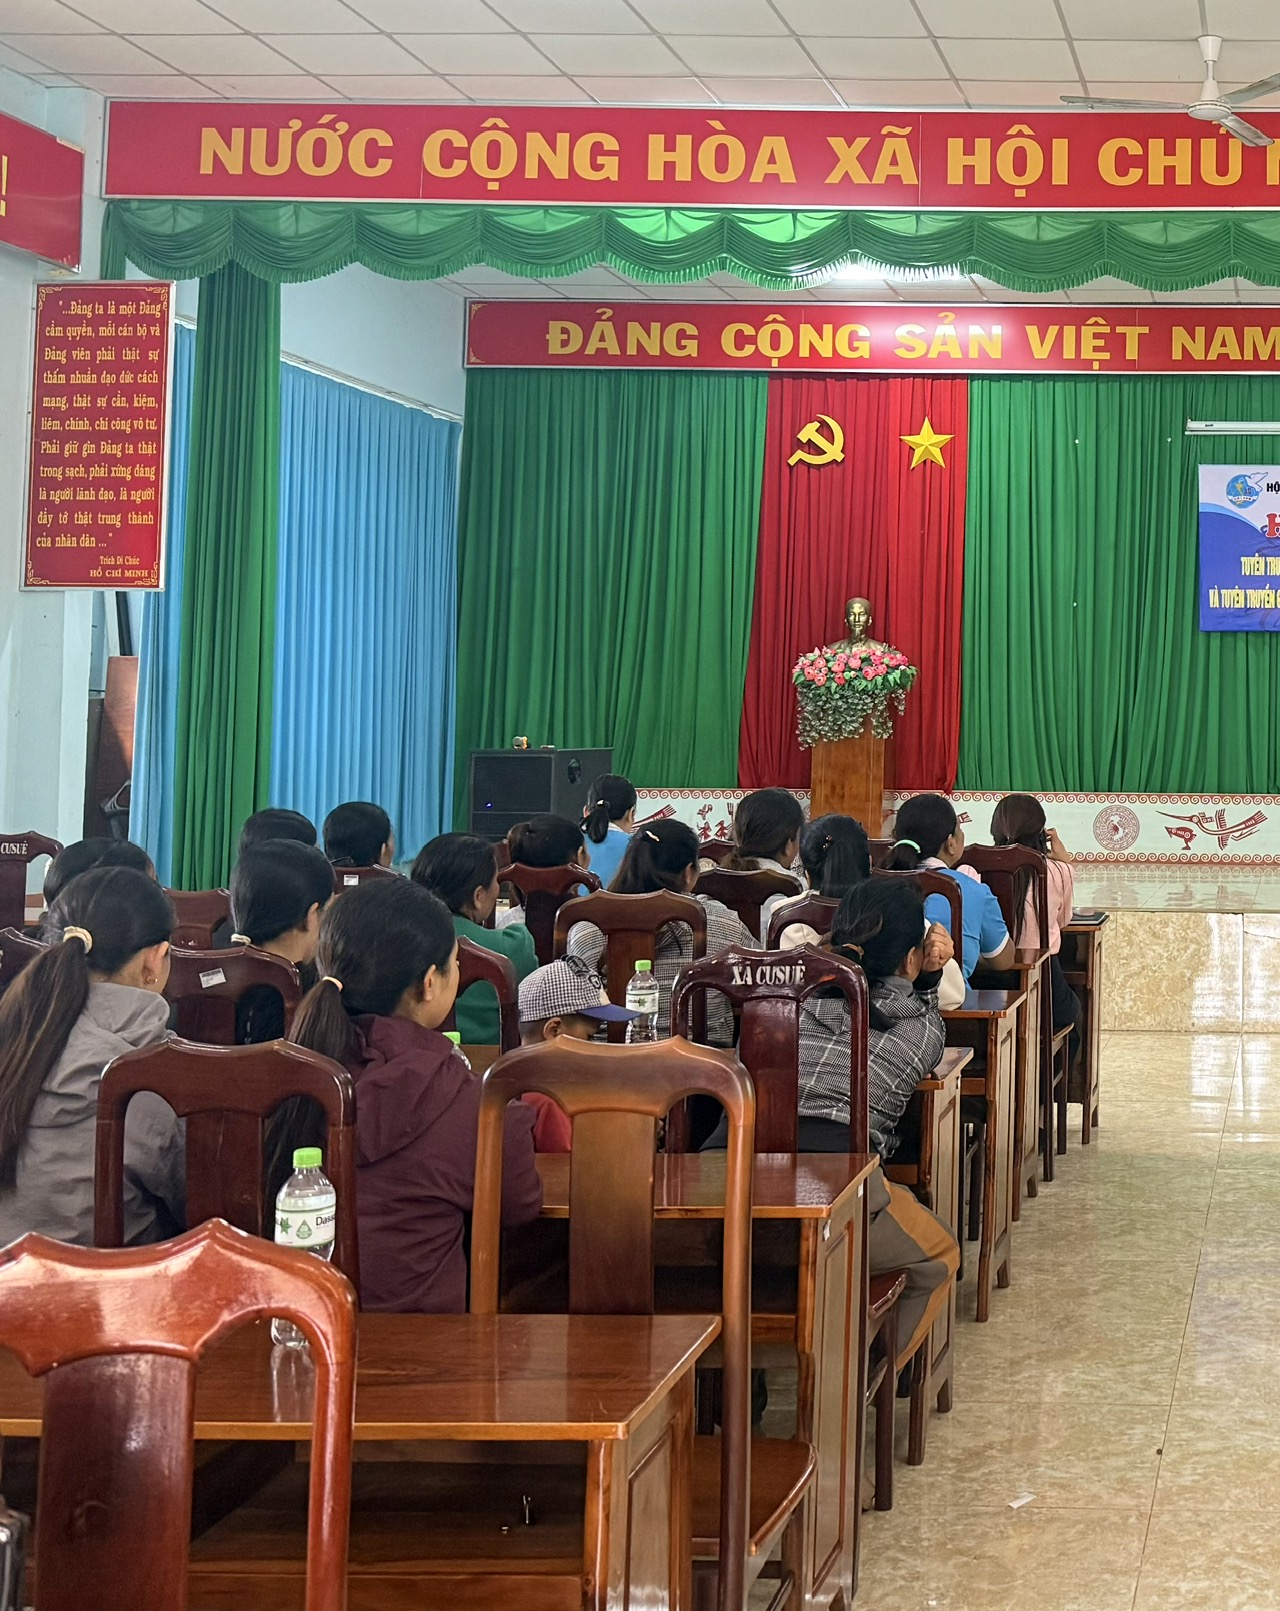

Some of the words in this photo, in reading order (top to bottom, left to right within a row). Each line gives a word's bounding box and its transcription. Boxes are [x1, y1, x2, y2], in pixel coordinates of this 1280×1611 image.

[202, 116, 392, 176] NƯỚC
[424, 119, 618, 189] CỘNG
[649, 121, 796, 183] HÒA
[827, 126, 918, 184] XÃ
[948, 125, 1068, 197] HỘI
[1099, 126, 1243, 186] CHỦ
[95, 301, 104, 315] ta
[107, 301, 116, 315] là
[139, 299, 161, 319] Đảng
[118, 323, 133, 336] cán
[136, 323, 147, 340] bộ
[149, 323, 161, 336] và
[548, 309, 698, 356] ĐẢNG
[722, 315, 870, 367] CỘNG
[896, 313, 1002, 359] SẢN
[1026, 318, 1149, 370] VIỆT
[44, 345, 67, 364] Đảng
[72, 347, 91, 360] viên
[96, 345, 115, 364] phải
[122, 347, 140, 363] thật
[137, 369, 159, 383] cách
[73, 393, 91, 410] thật
[94, 417, 109, 430] chí
[111, 417, 131, 432] công
[133, 417, 144, 430] vô
[40, 439, 60, 454] Phải
[100, 439, 123, 458] Đảng
[125, 441, 134, 454] ta
[138, 441, 157, 457] thật
[40, 465, 63, 481] trong
[89, 462, 108, 481] phải
[39, 487, 47, 500] là
[49, 488, 74, 506] người
[119, 487, 128, 500] là
[130, 487, 155, 506] người
[74, 511, 93, 527] thật
[97, 512, 122, 528] trung
[128, 511, 154, 525] thành
[36, 532, 52, 547] của
[55, 533, 77, 547] nhân
[79, 533, 96, 547] dân
[124, 569, 148, 578] MINH
